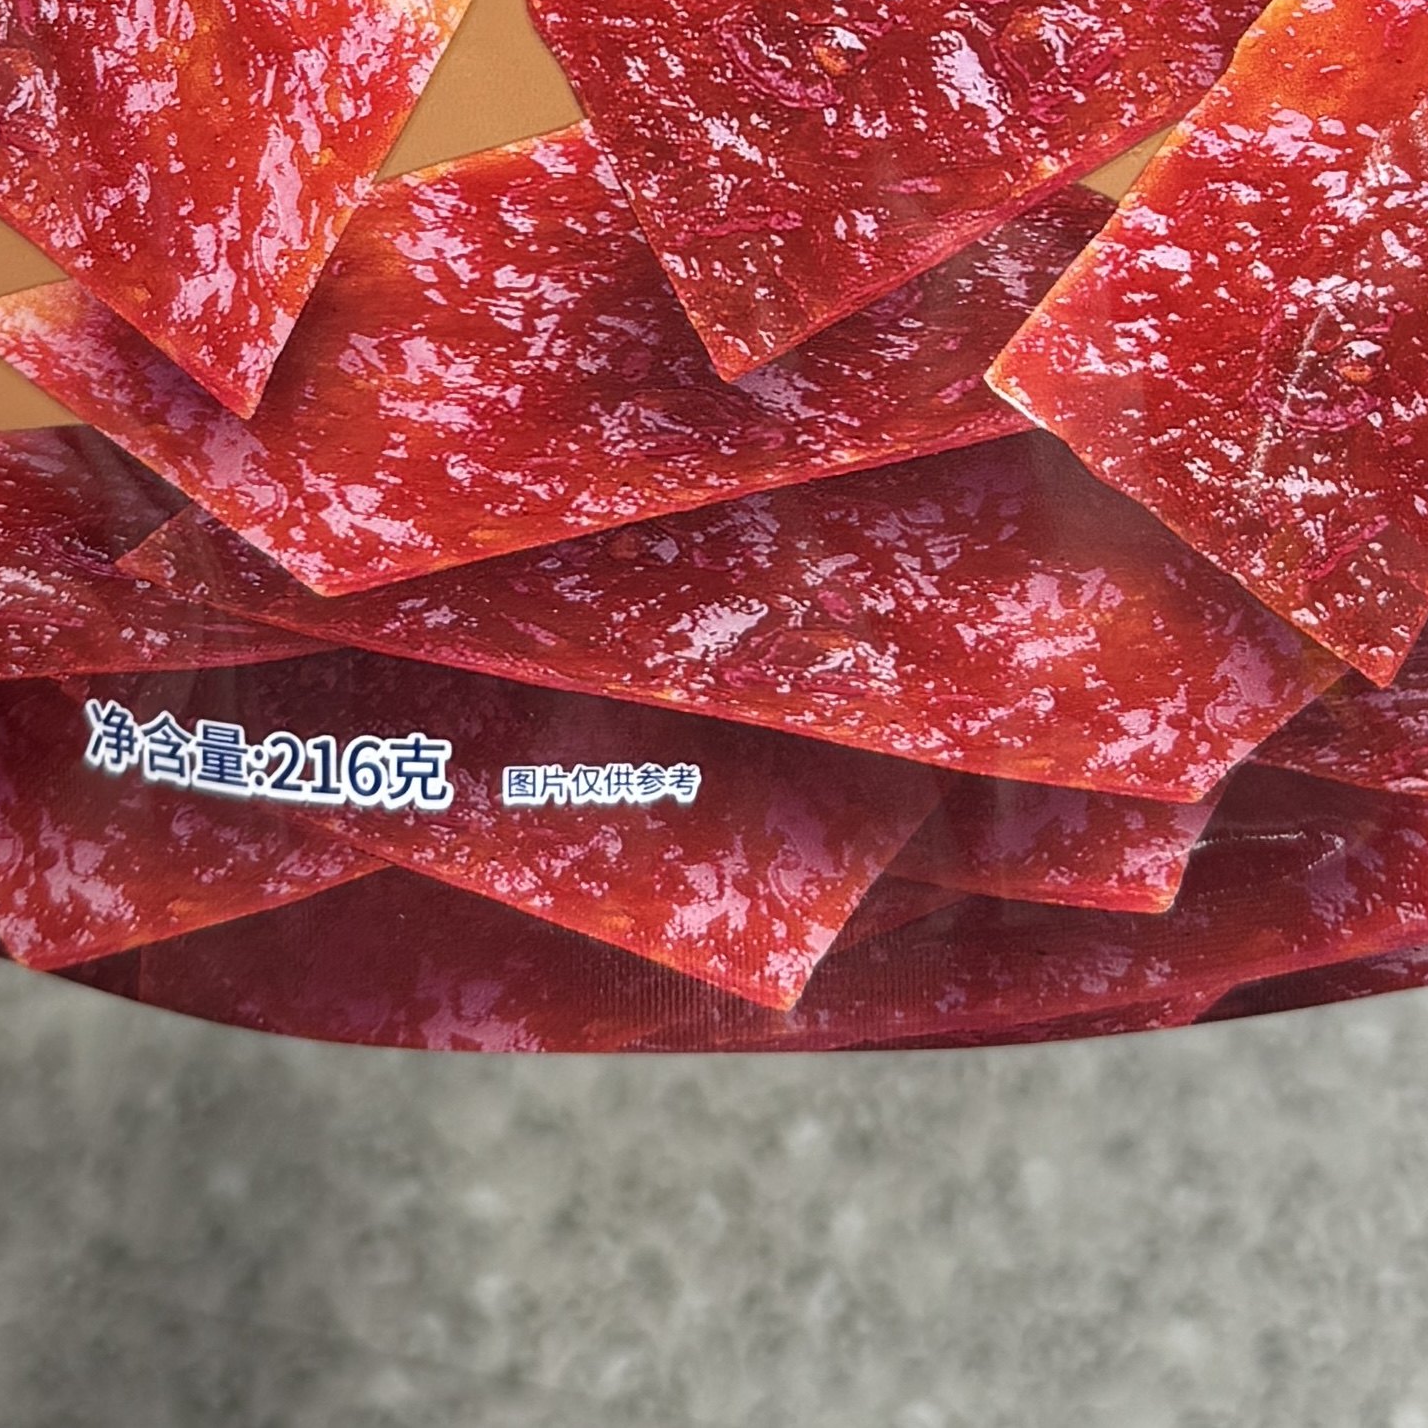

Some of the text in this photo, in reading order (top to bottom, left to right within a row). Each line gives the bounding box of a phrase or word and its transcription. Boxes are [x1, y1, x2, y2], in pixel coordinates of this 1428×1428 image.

[86, 699, 451, 805] 净含量:216克
[505, 763, 701, 802] 图片仅供参考
